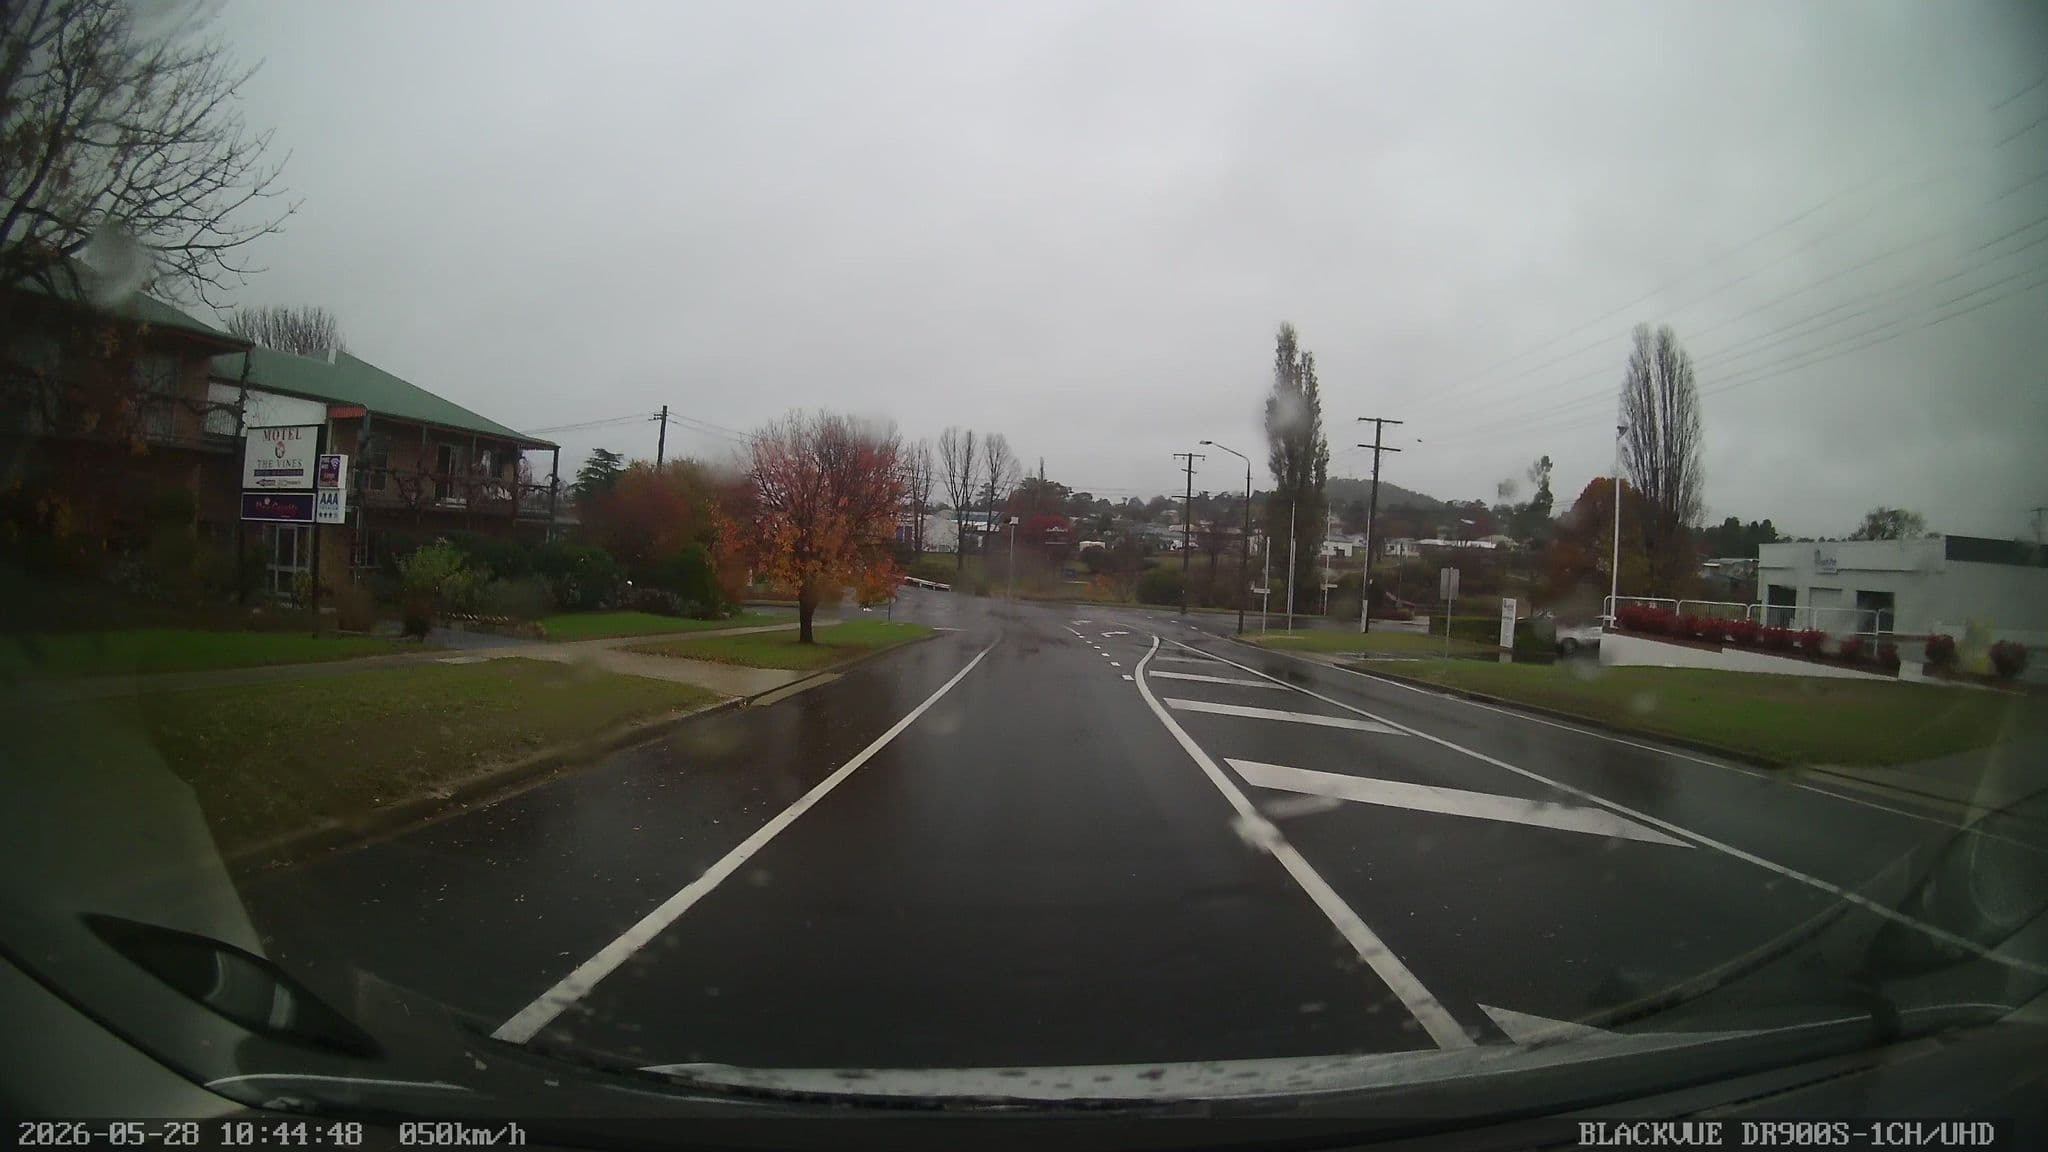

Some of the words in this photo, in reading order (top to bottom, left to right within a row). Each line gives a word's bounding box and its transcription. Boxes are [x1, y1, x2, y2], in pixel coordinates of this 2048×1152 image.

[263, 428, 302, 442] MOTEL
[257, 459, 273, 468] THE
[277, 458, 303, 468] VINES
[320, 492, 338, 505] AAA
